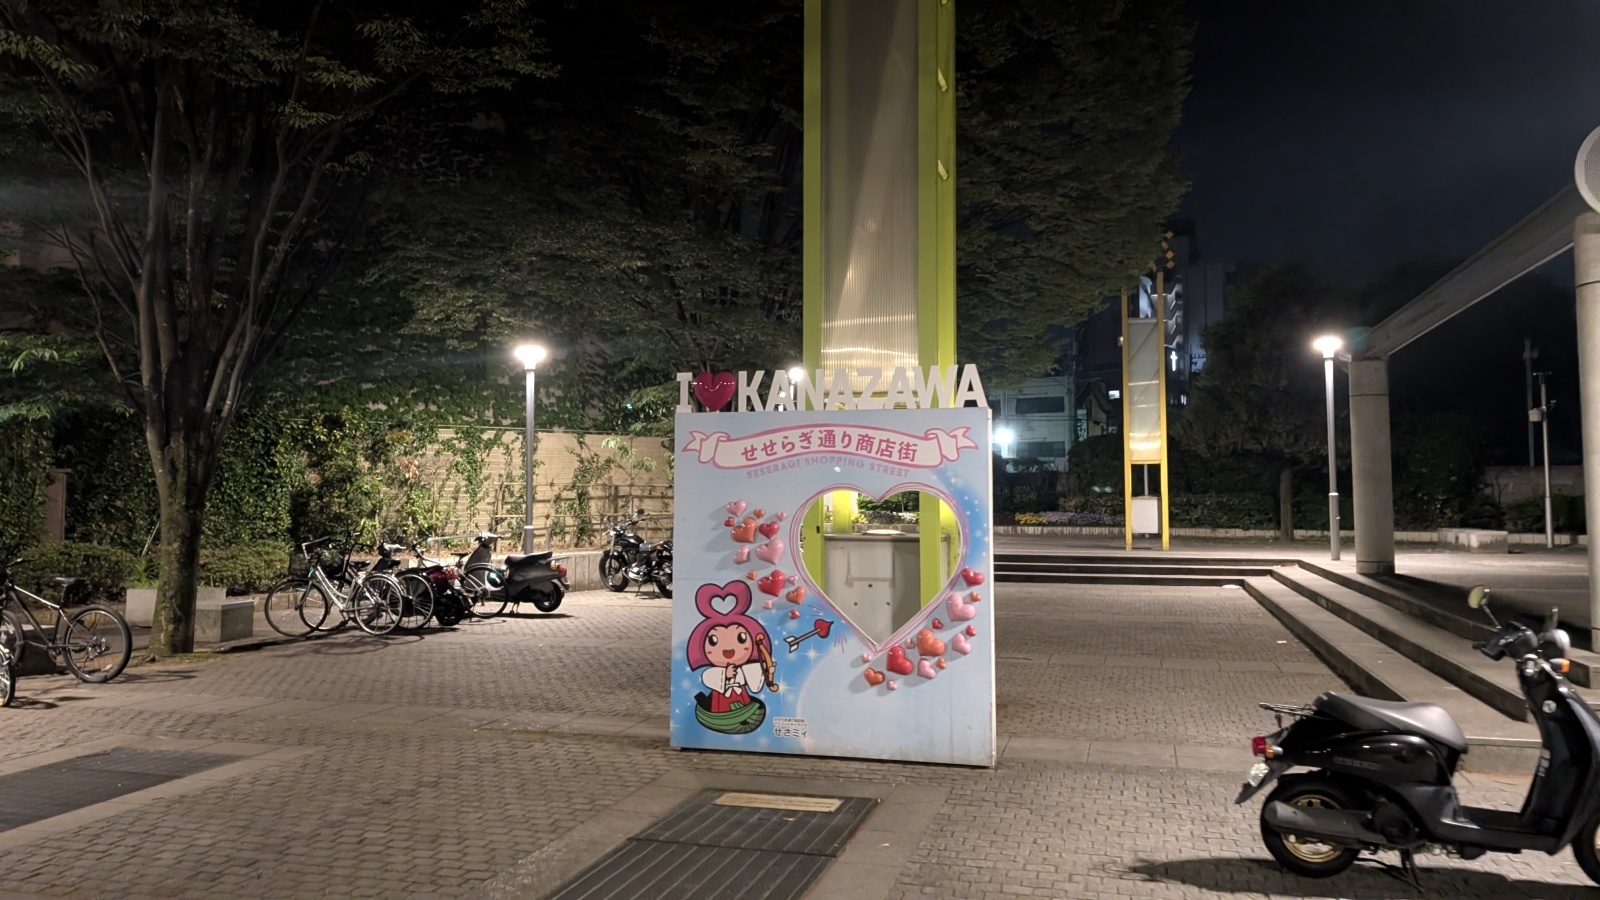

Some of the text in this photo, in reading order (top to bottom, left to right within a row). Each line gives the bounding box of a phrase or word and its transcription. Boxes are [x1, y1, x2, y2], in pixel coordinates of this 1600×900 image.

[676, 363, 989, 412] I KANAZAWA
[741, 429, 918, 462] せせらぎ通り商店街
[746, 456, 910, 479] SESERAGI SHOPPING STREET
